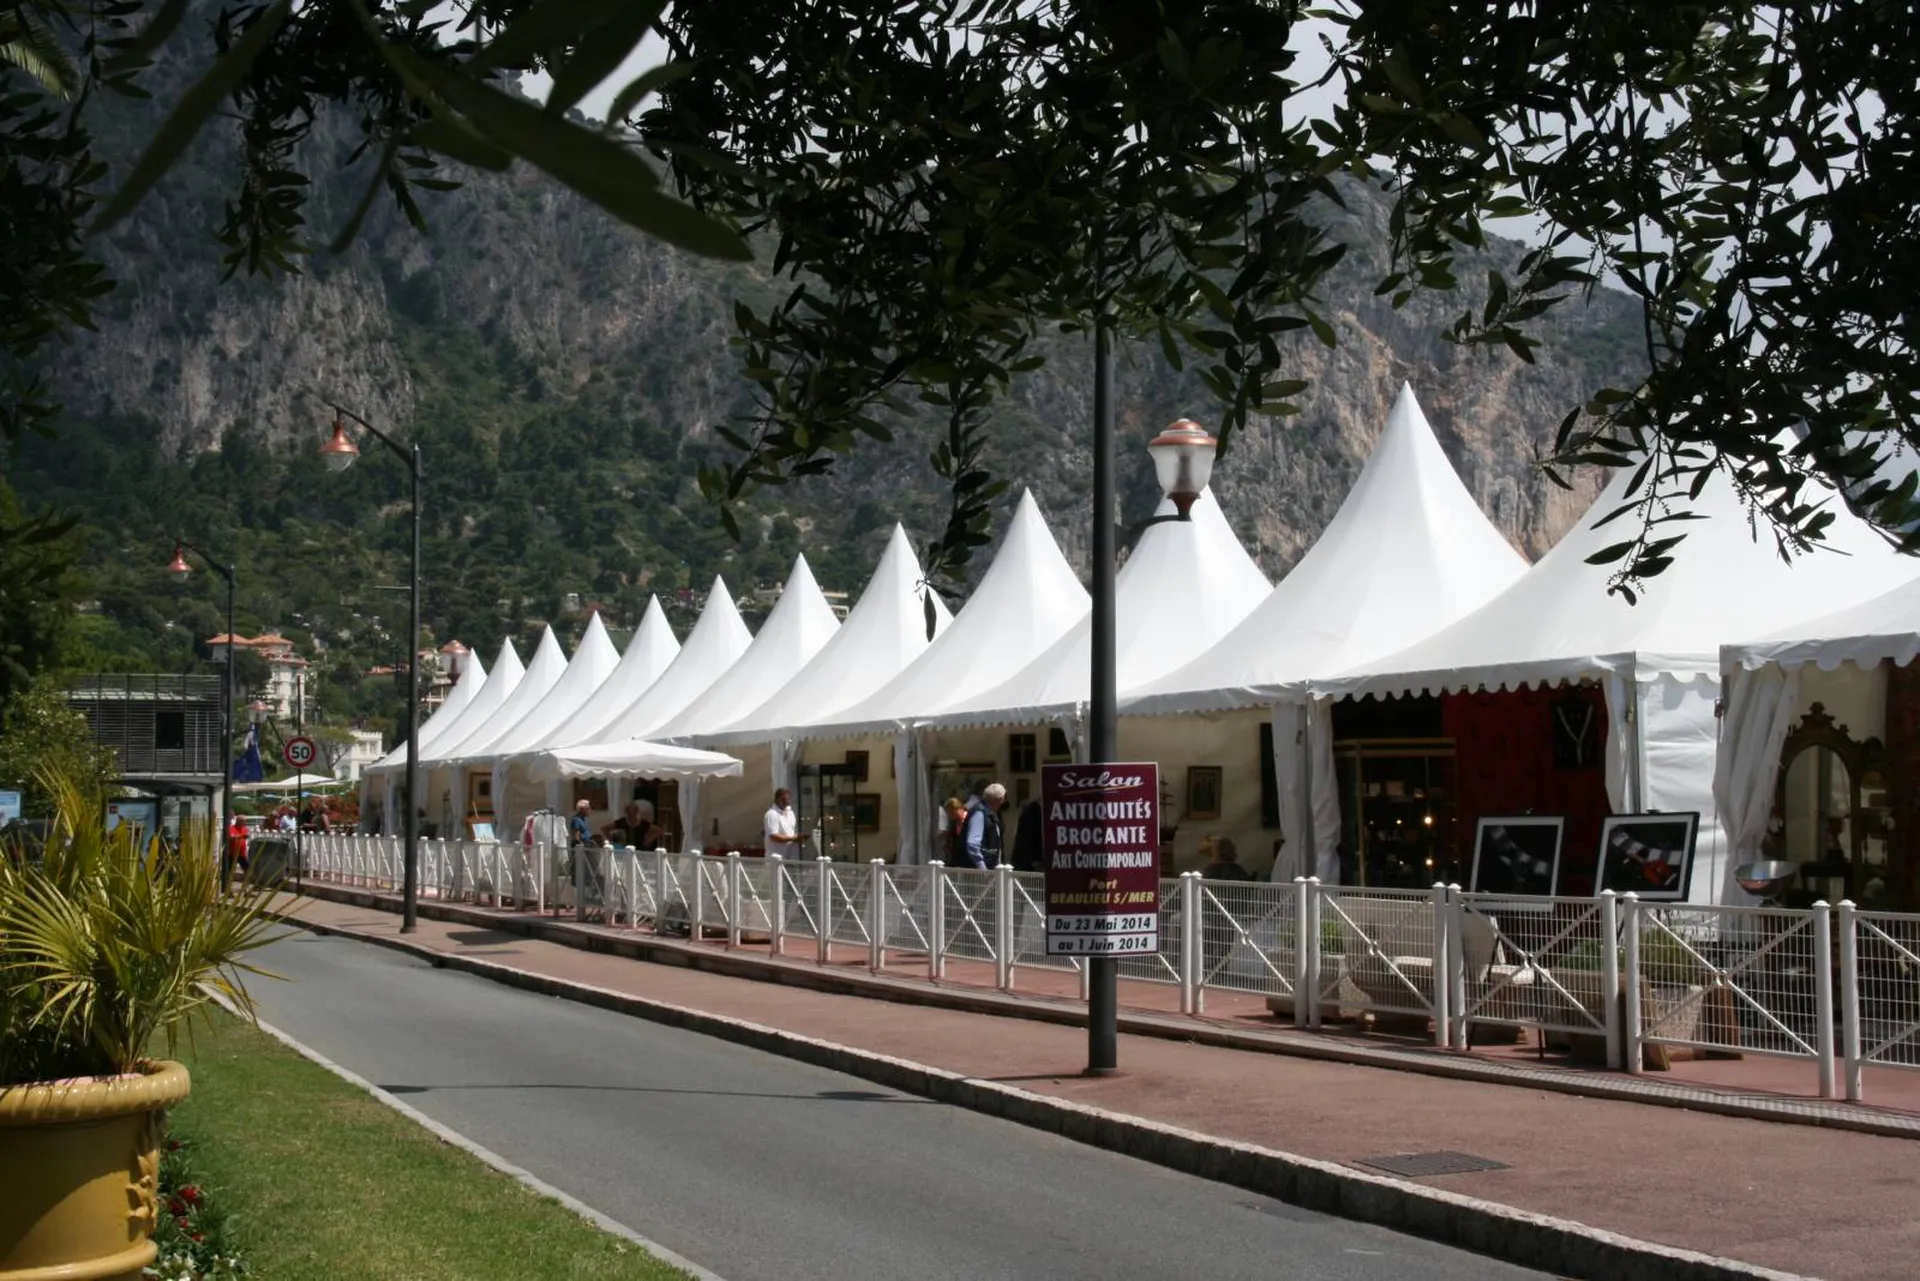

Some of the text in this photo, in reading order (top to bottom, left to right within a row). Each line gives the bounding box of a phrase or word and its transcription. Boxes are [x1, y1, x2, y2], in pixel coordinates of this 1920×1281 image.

[291, 746, 310, 759] 50
[1057, 771, 1144, 788] Salon
[1050, 798, 1151, 821] ANTIQUITÉS
[1056, 826, 1147, 845] BROCANTE
[1052, 850, 1152, 869] ART CONTEMPORAIN
[1089, 878, 1118, 890] Port
[1051, 891, 1155, 905] BEAULIEU S/MER
[1055, 917, 1151, 930] Du 23 Mai 2014
[1058, 937, 1149, 950] au 1 Juin 2014
